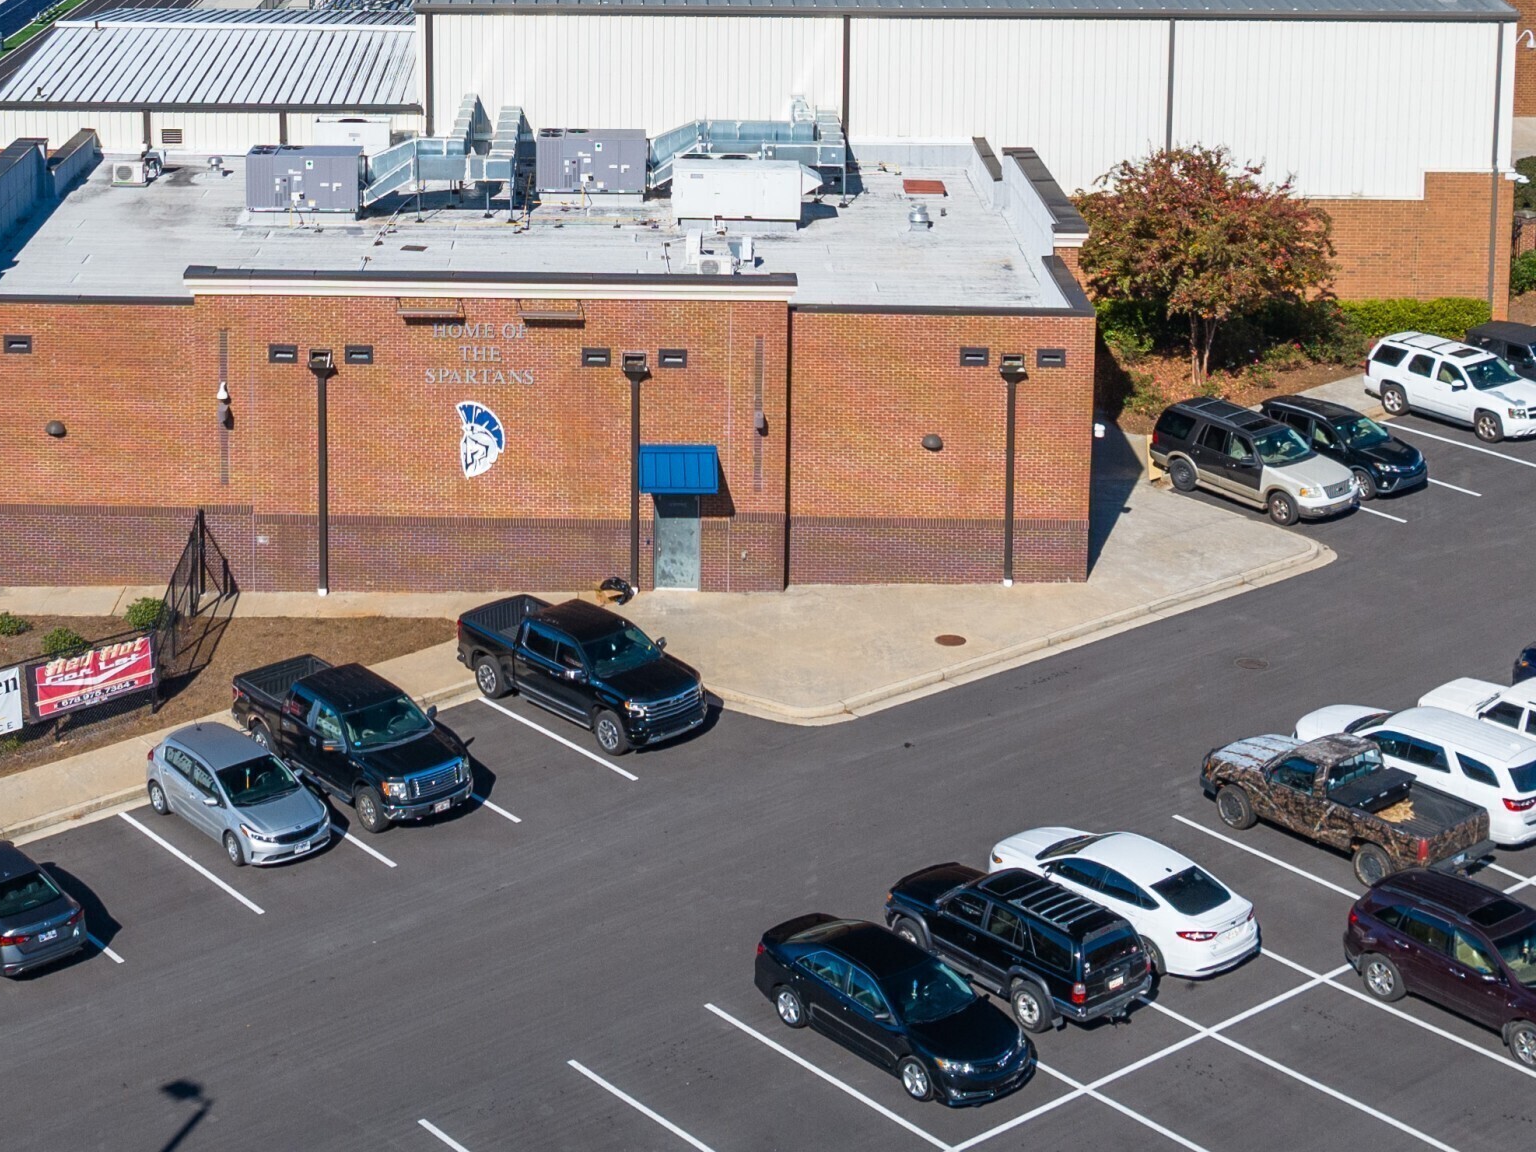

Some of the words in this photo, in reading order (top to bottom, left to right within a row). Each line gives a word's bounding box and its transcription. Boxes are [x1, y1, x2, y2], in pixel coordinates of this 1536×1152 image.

[432, 322, 495, 339] HOME
[502, 322, 529, 339] OF
[460, 346, 502, 362] THE
[425, 368, 534, 385] SPARTANS
[45, 650, 94, 676] Red
[99, 636, 142, 662] Hot
[46, 668, 94, 686] Car
[98, 653, 140, 671] Lot
